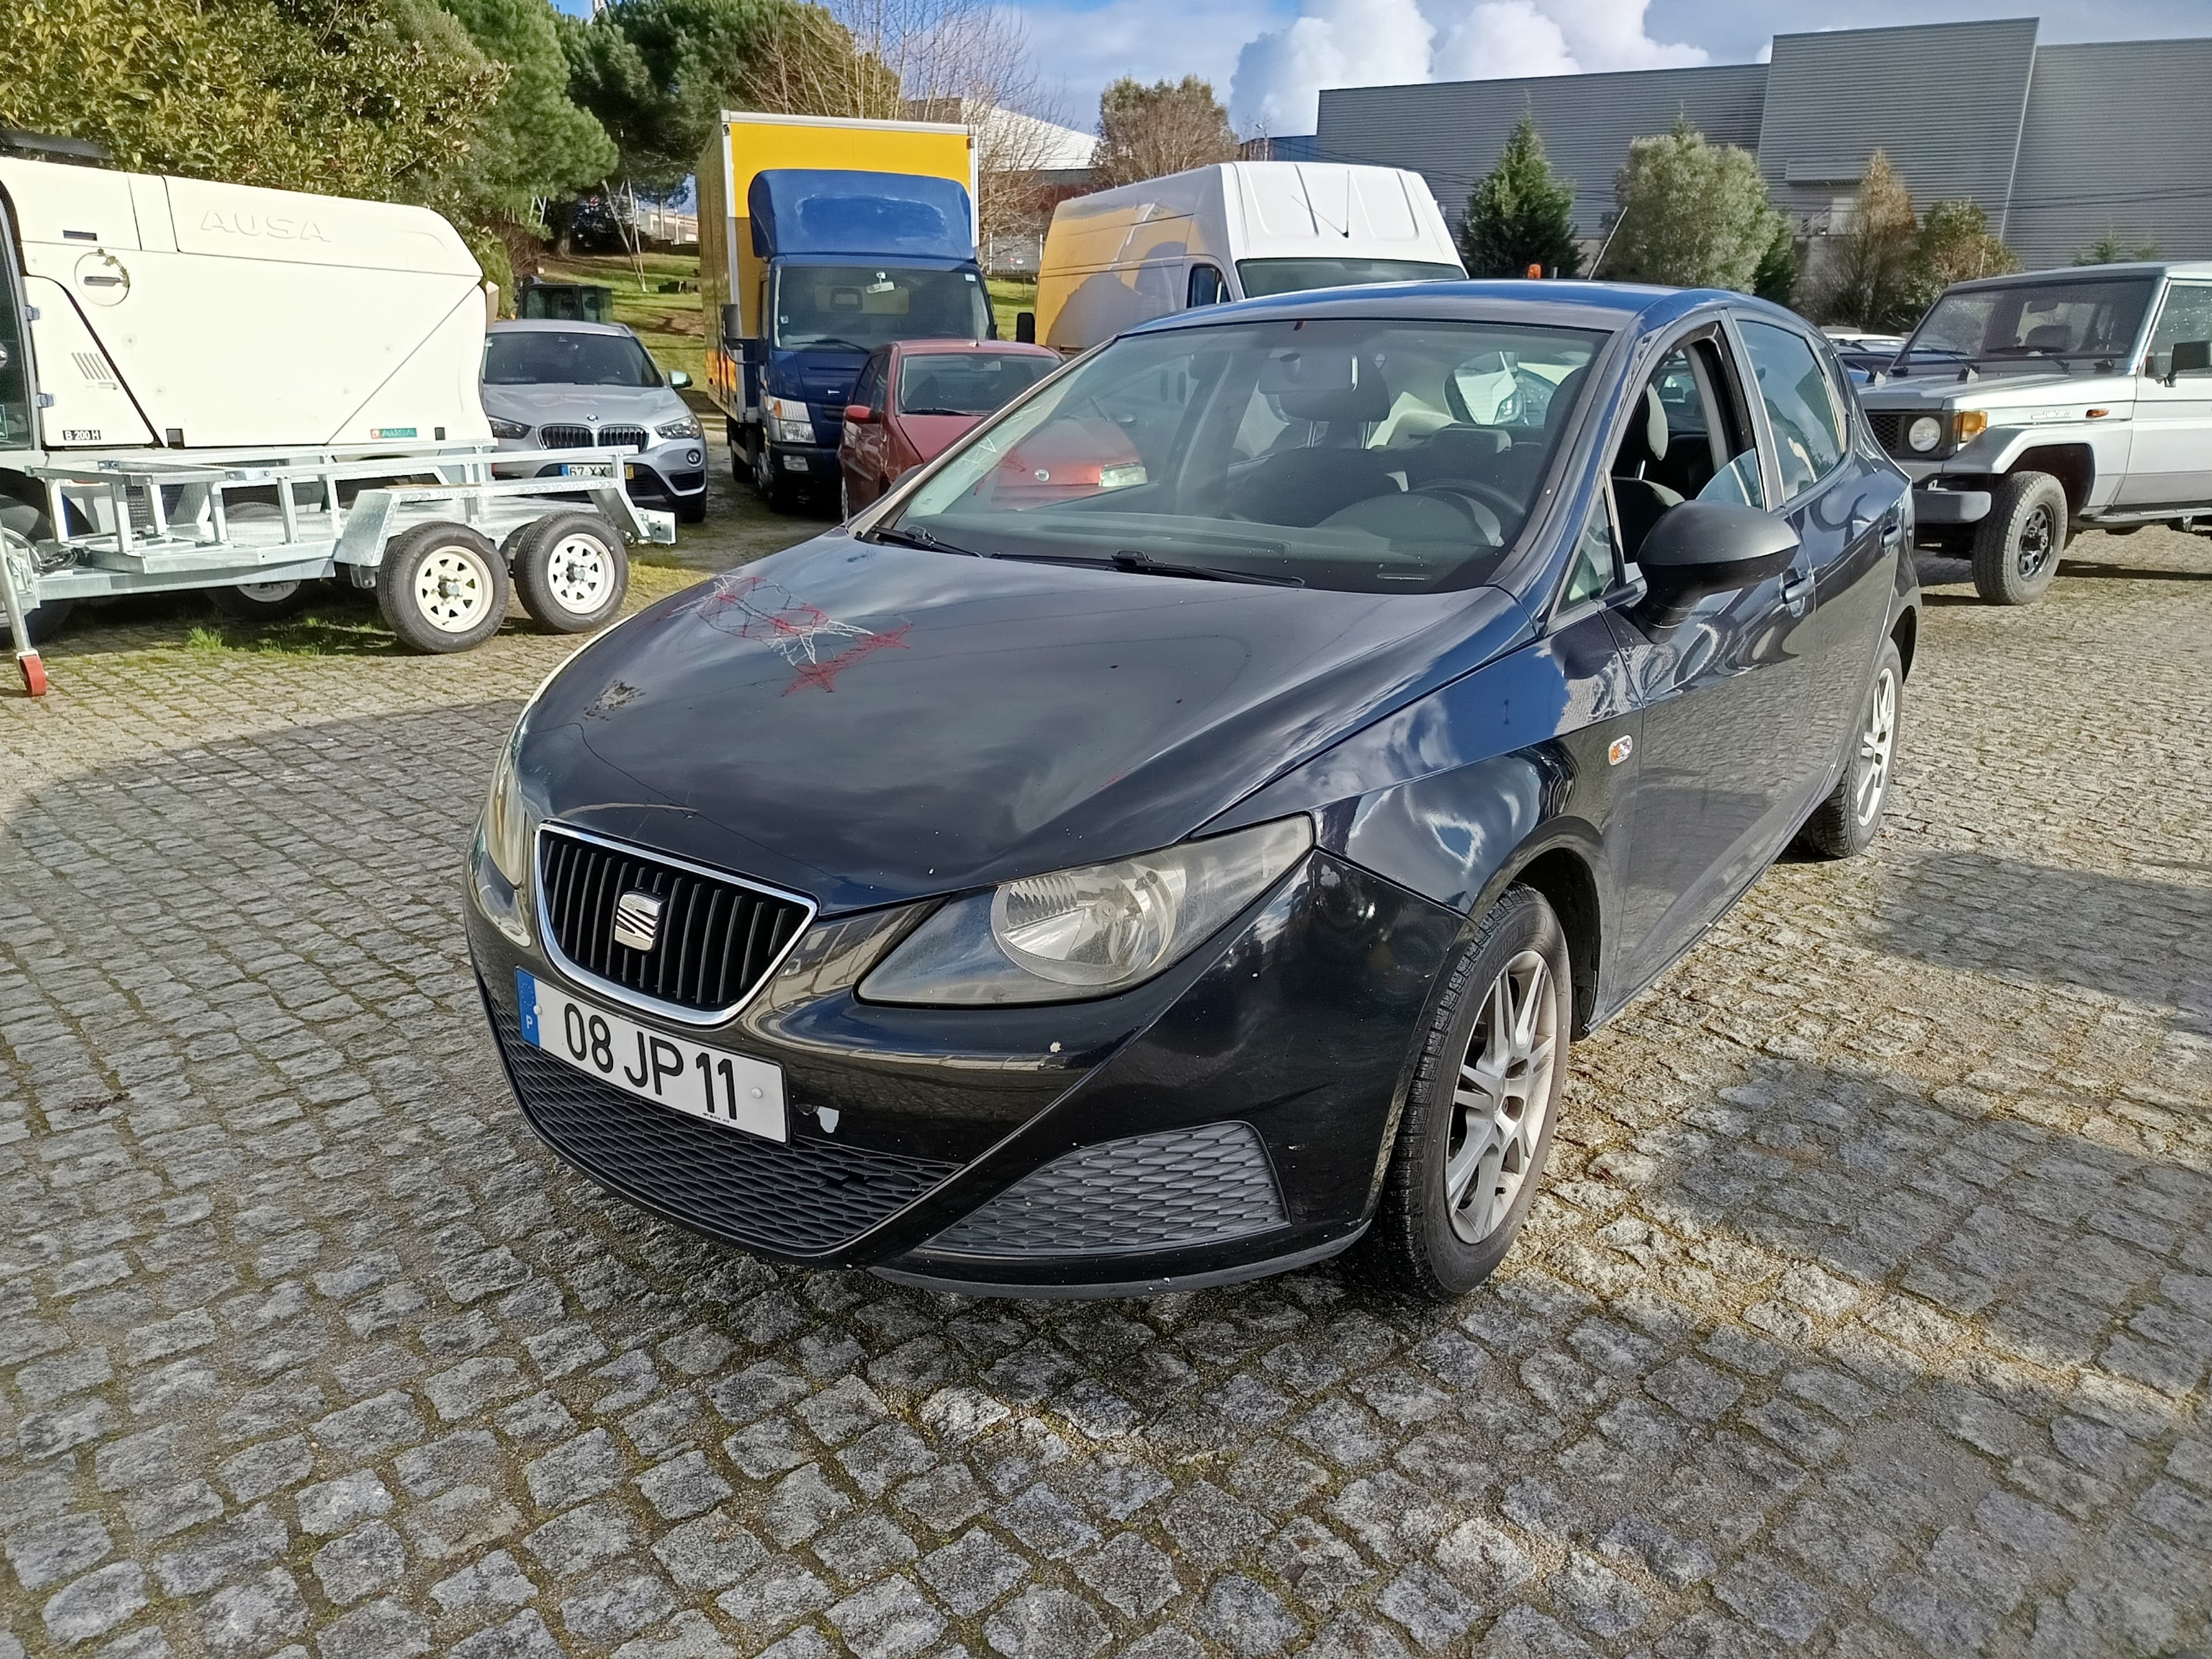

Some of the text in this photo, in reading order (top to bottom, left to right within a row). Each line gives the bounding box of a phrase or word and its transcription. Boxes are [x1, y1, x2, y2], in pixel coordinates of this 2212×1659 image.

[200, 209, 332, 243] AUSA
[65, 430, 100, 441] B 200 H
[525, 1014, 533, 1030] P
[564, 1002, 737, 1120] 08 JP 11
